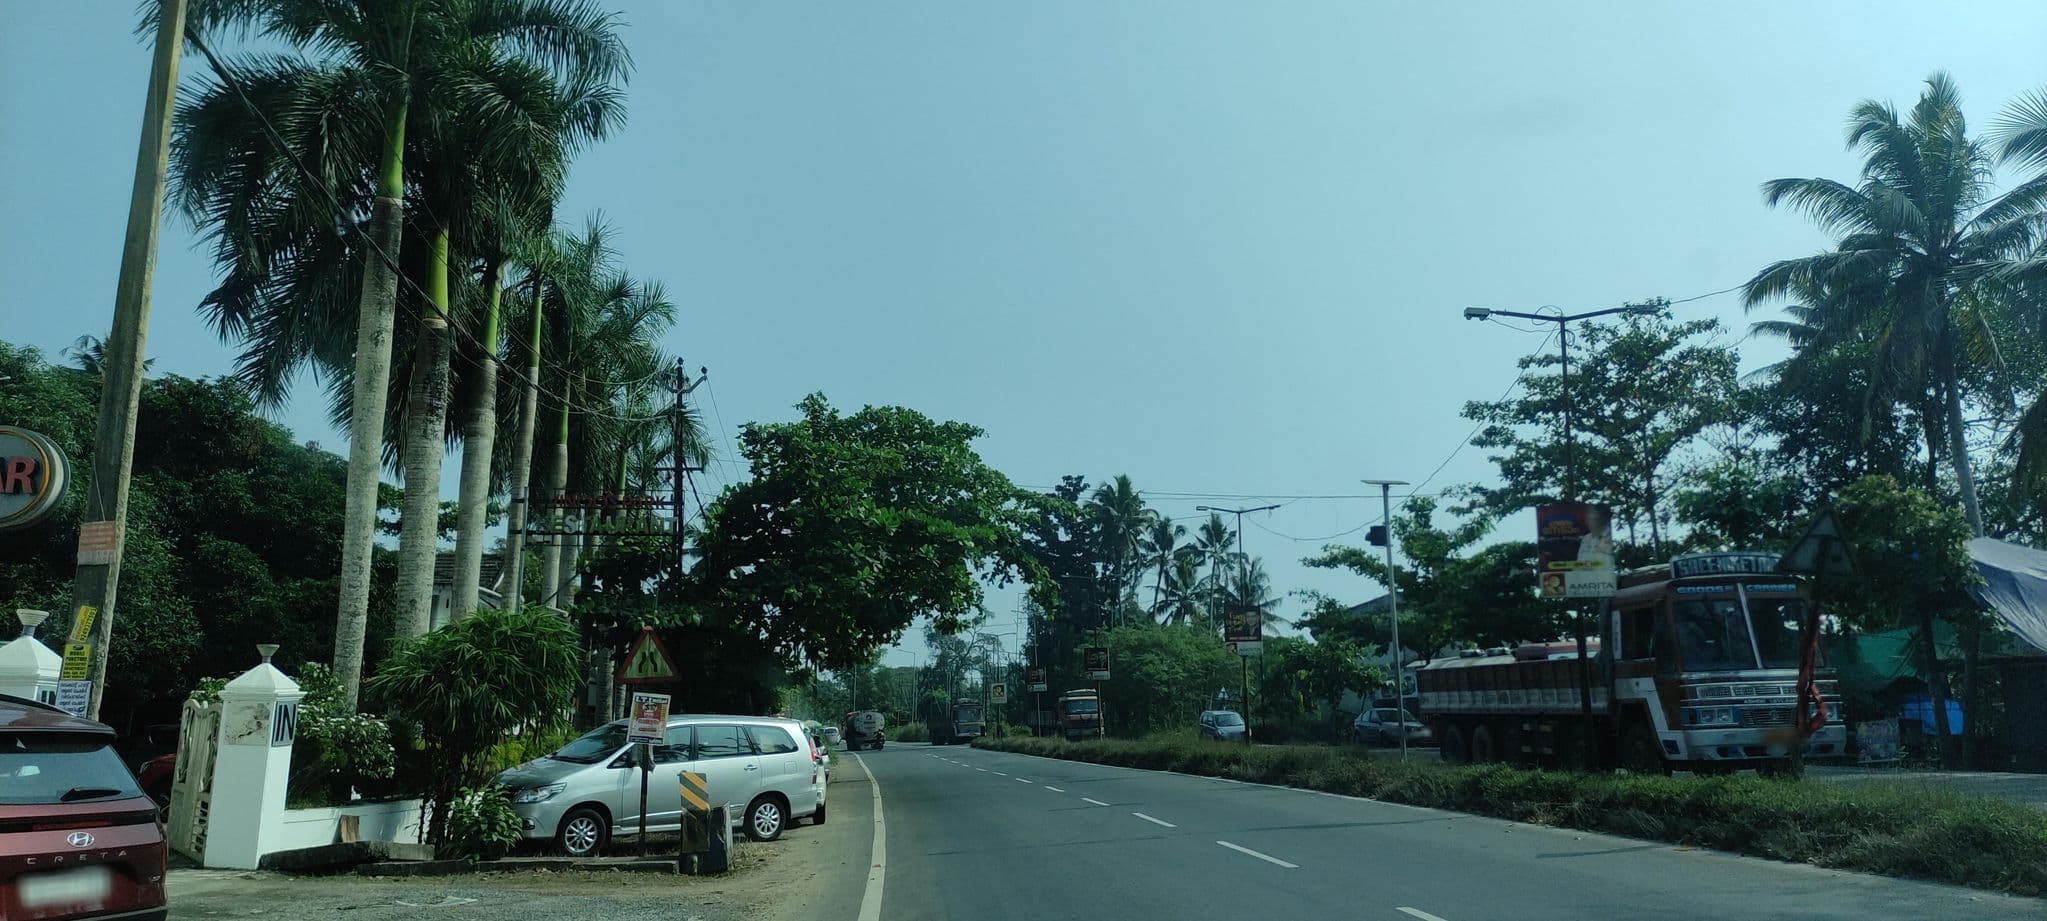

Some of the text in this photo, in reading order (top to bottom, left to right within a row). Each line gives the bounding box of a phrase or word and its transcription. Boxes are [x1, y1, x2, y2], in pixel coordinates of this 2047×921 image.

[0, 456, 36, 494] R
[1568, 582, 1615, 591] AMRITA
[275, 703, 297, 742] IN
[26, 850, 129, 865] CRETA
